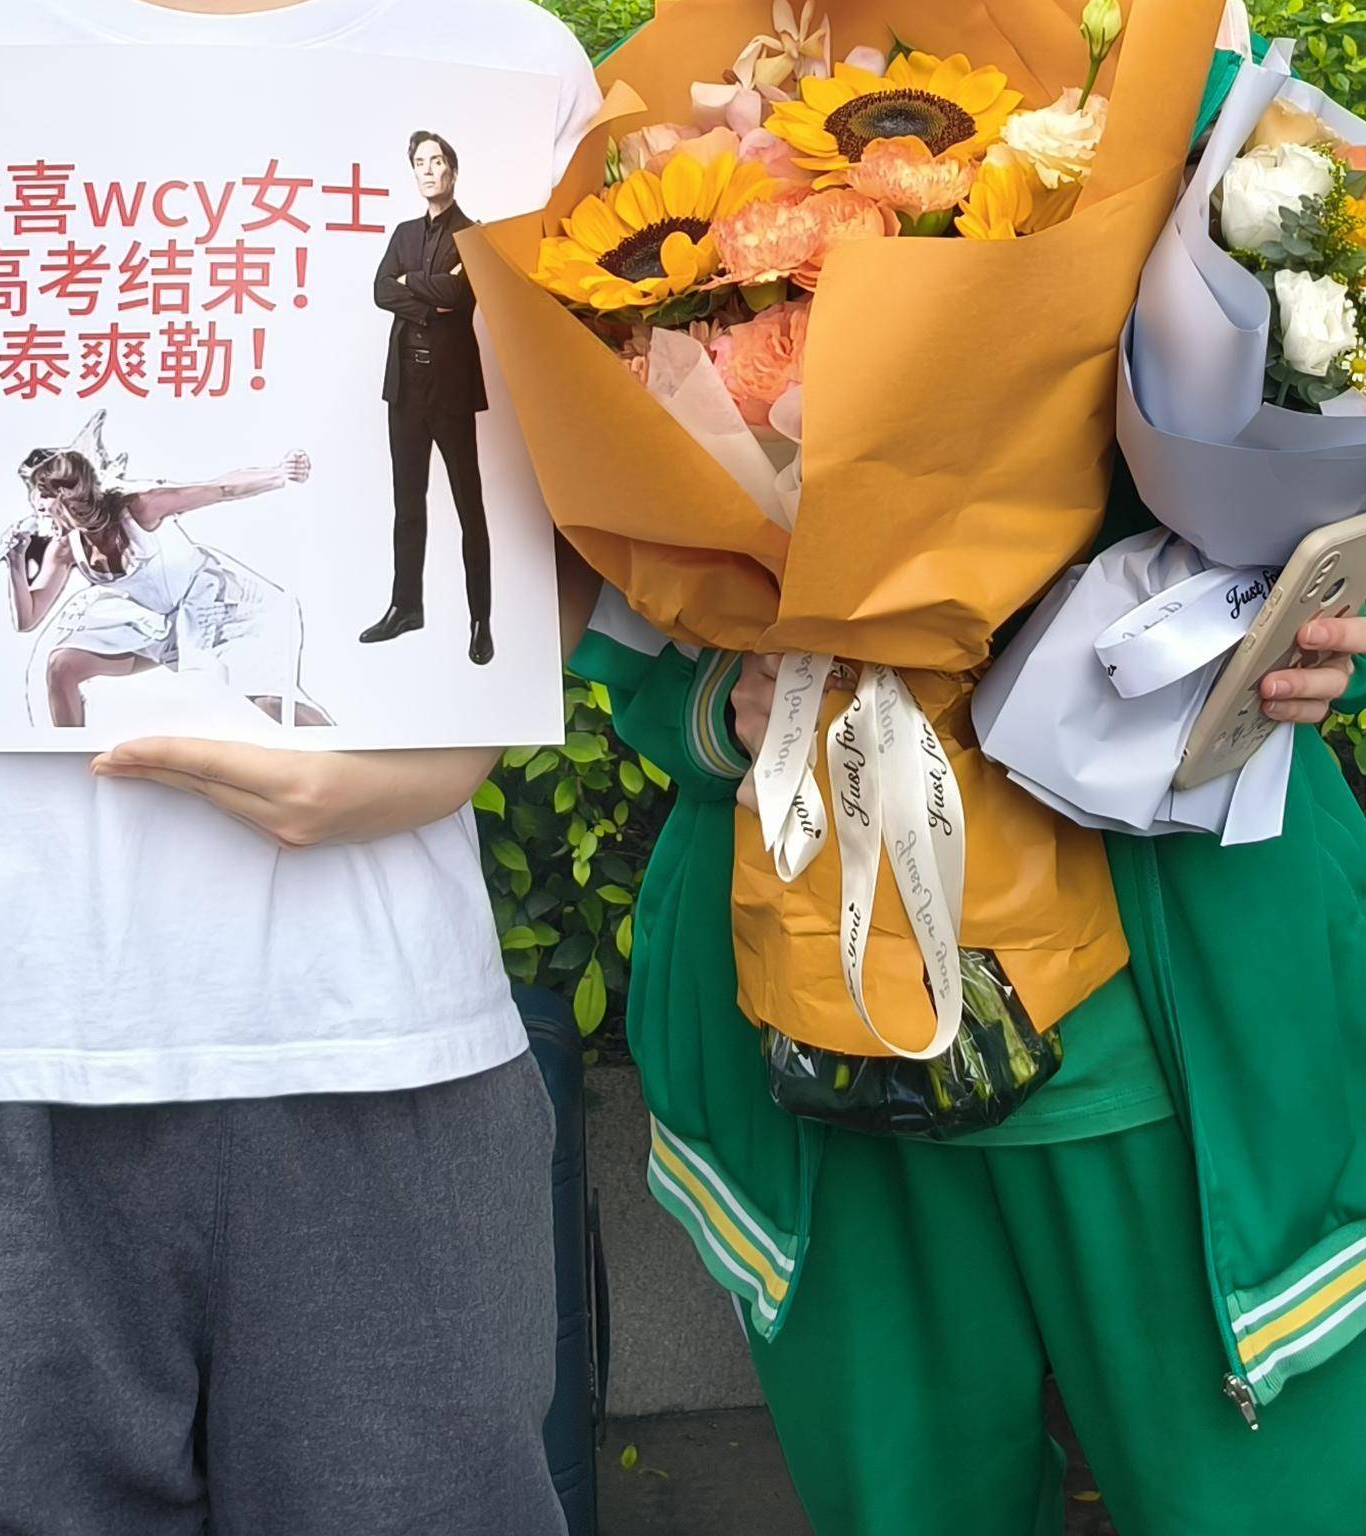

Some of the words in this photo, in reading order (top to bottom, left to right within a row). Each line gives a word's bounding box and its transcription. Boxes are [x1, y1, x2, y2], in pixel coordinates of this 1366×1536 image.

[1226, 578, 1265, 620] Just
[1261, 568, 1280, 599] fo
[835, 715, 866, 767] for
[920, 723, 948, 775] for
[840, 762, 871, 827] Just
[927, 767, 953, 836] Just
